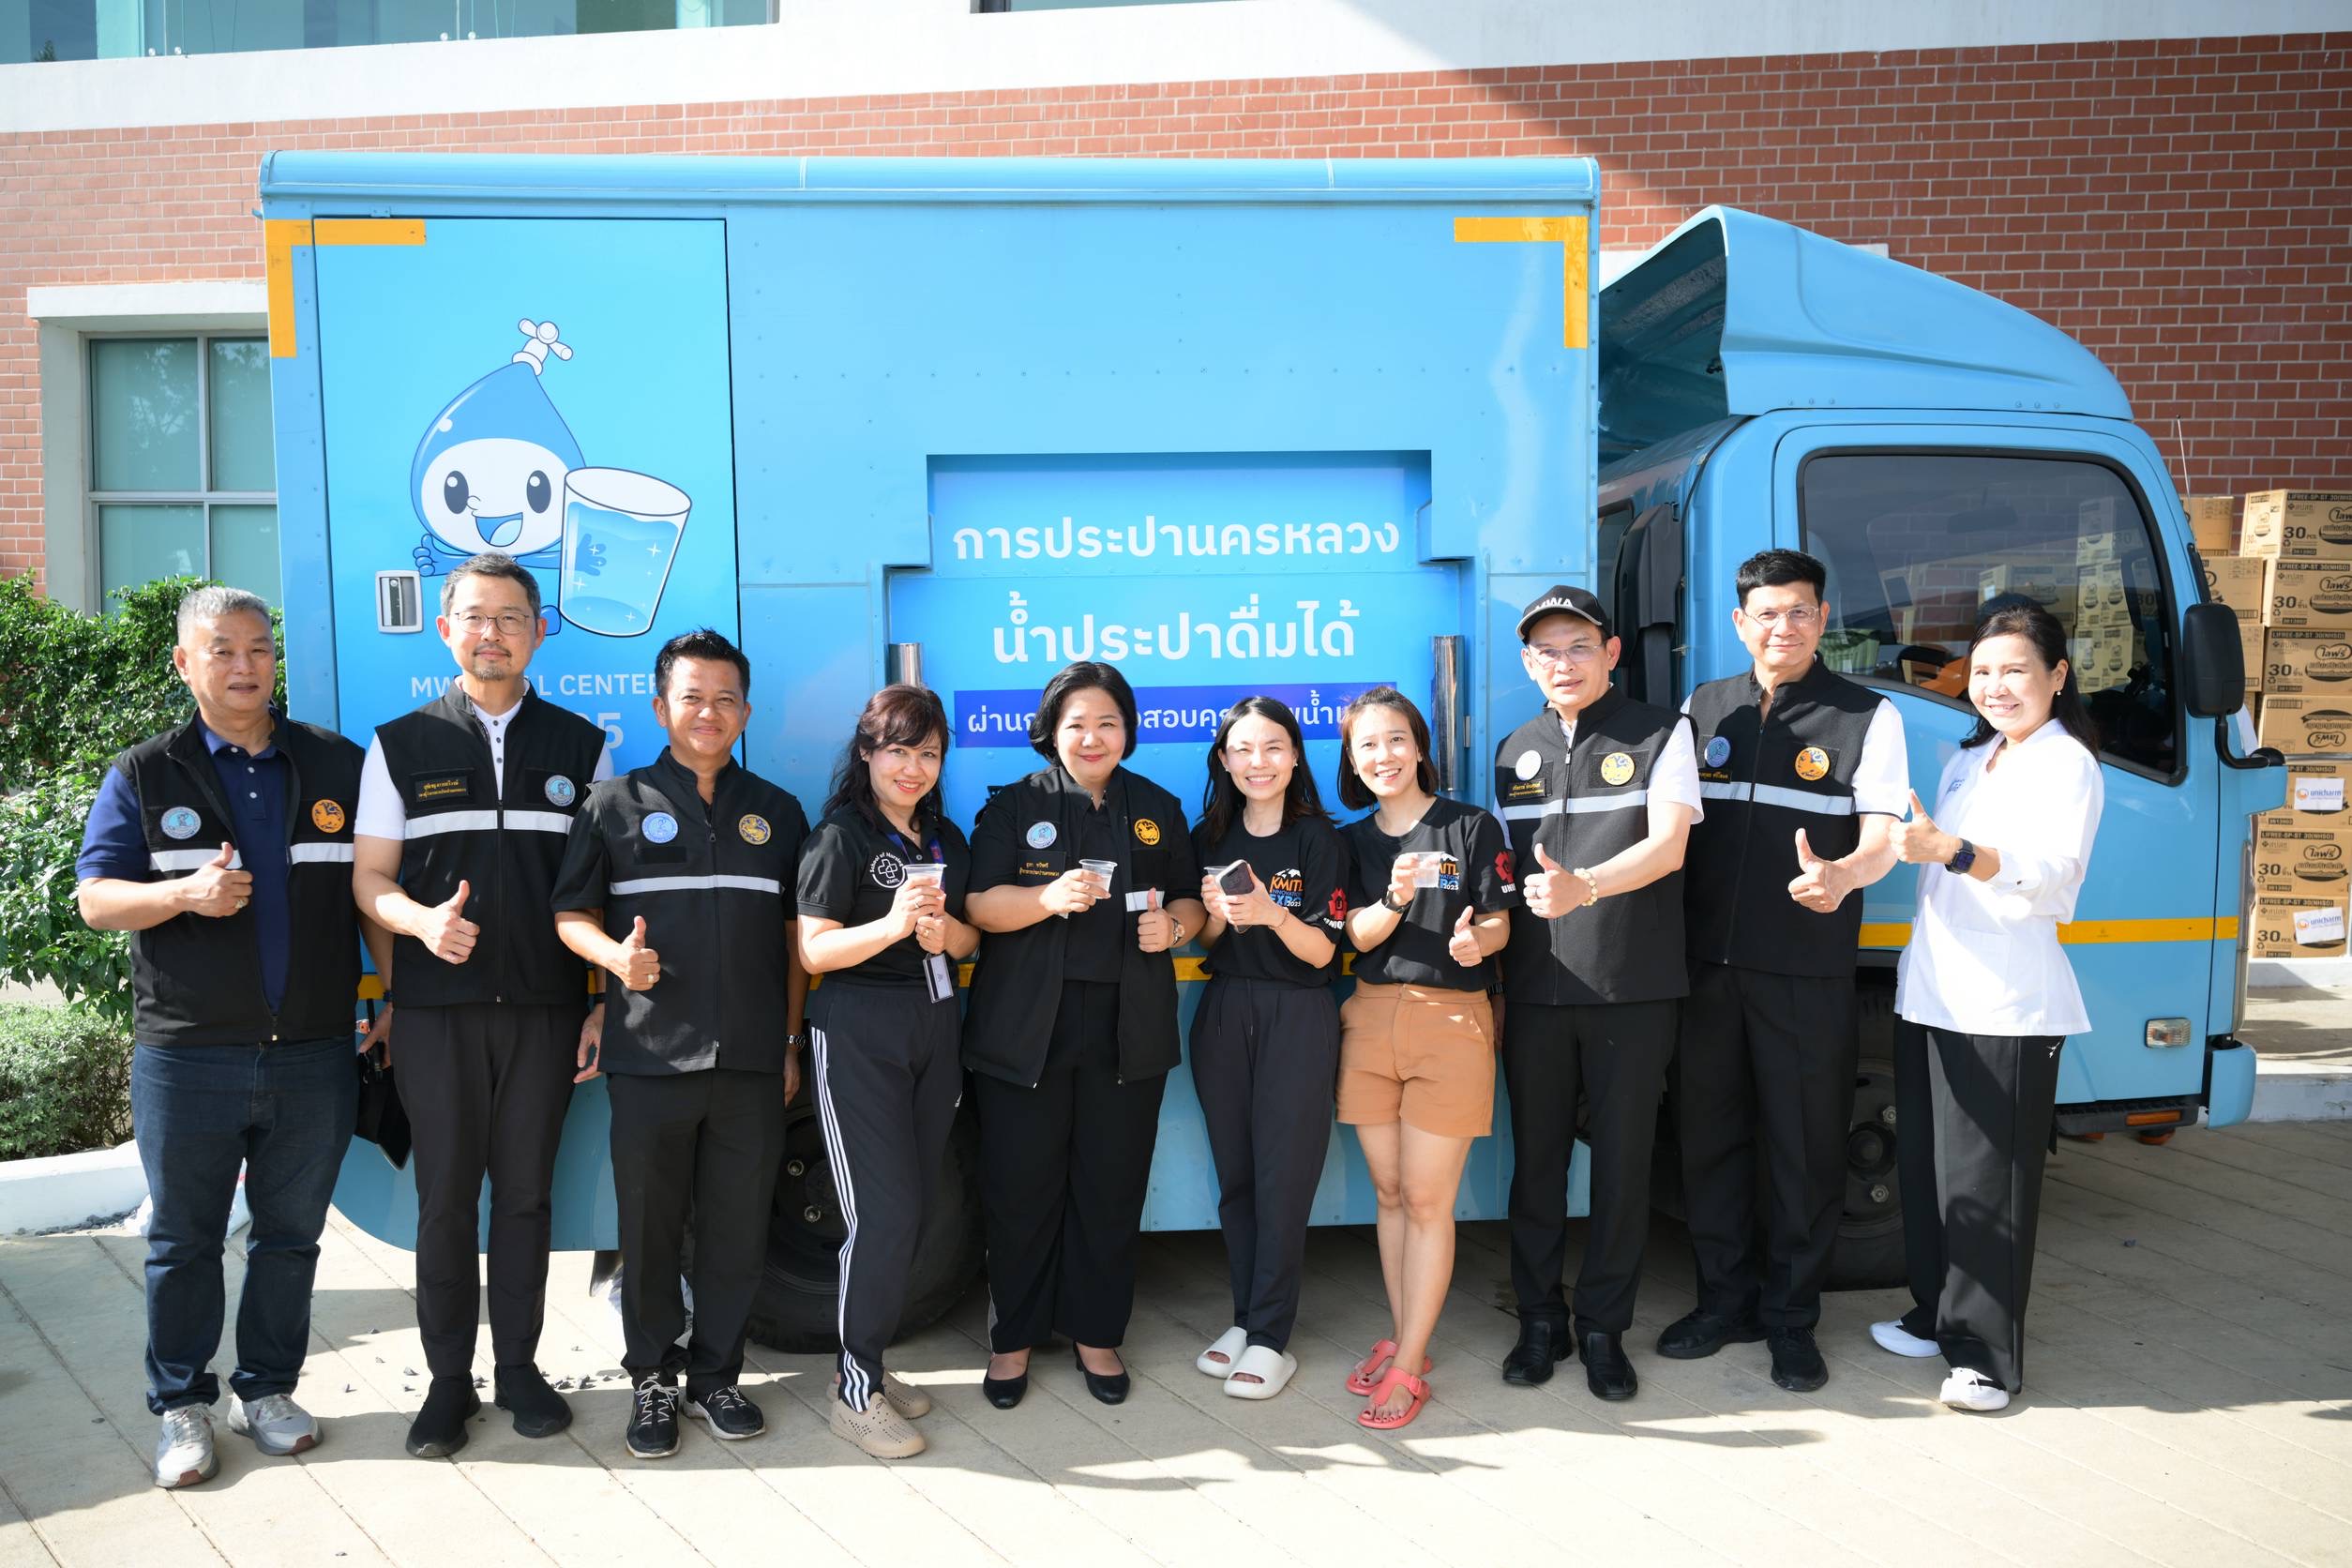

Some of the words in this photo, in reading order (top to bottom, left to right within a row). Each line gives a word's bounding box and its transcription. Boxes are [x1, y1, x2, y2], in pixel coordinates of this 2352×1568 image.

[953, 516, 1400, 560] การประปานครหลวง
[2284, 526, 2306, 539] 30
[2273, 596, 2297, 609] 30
[992, 592, 1359, 663] น้ำประปาดื่มได้
[2269, 664, 2292, 676] 30
[559, 673, 657, 695] CENTE
[2257, 863, 2281, 876] 30
[1269, 876, 1304, 893] KMITL
[2310, 915, 2342, 926] unicharm
[2256, 930, 2281, 942] 30
